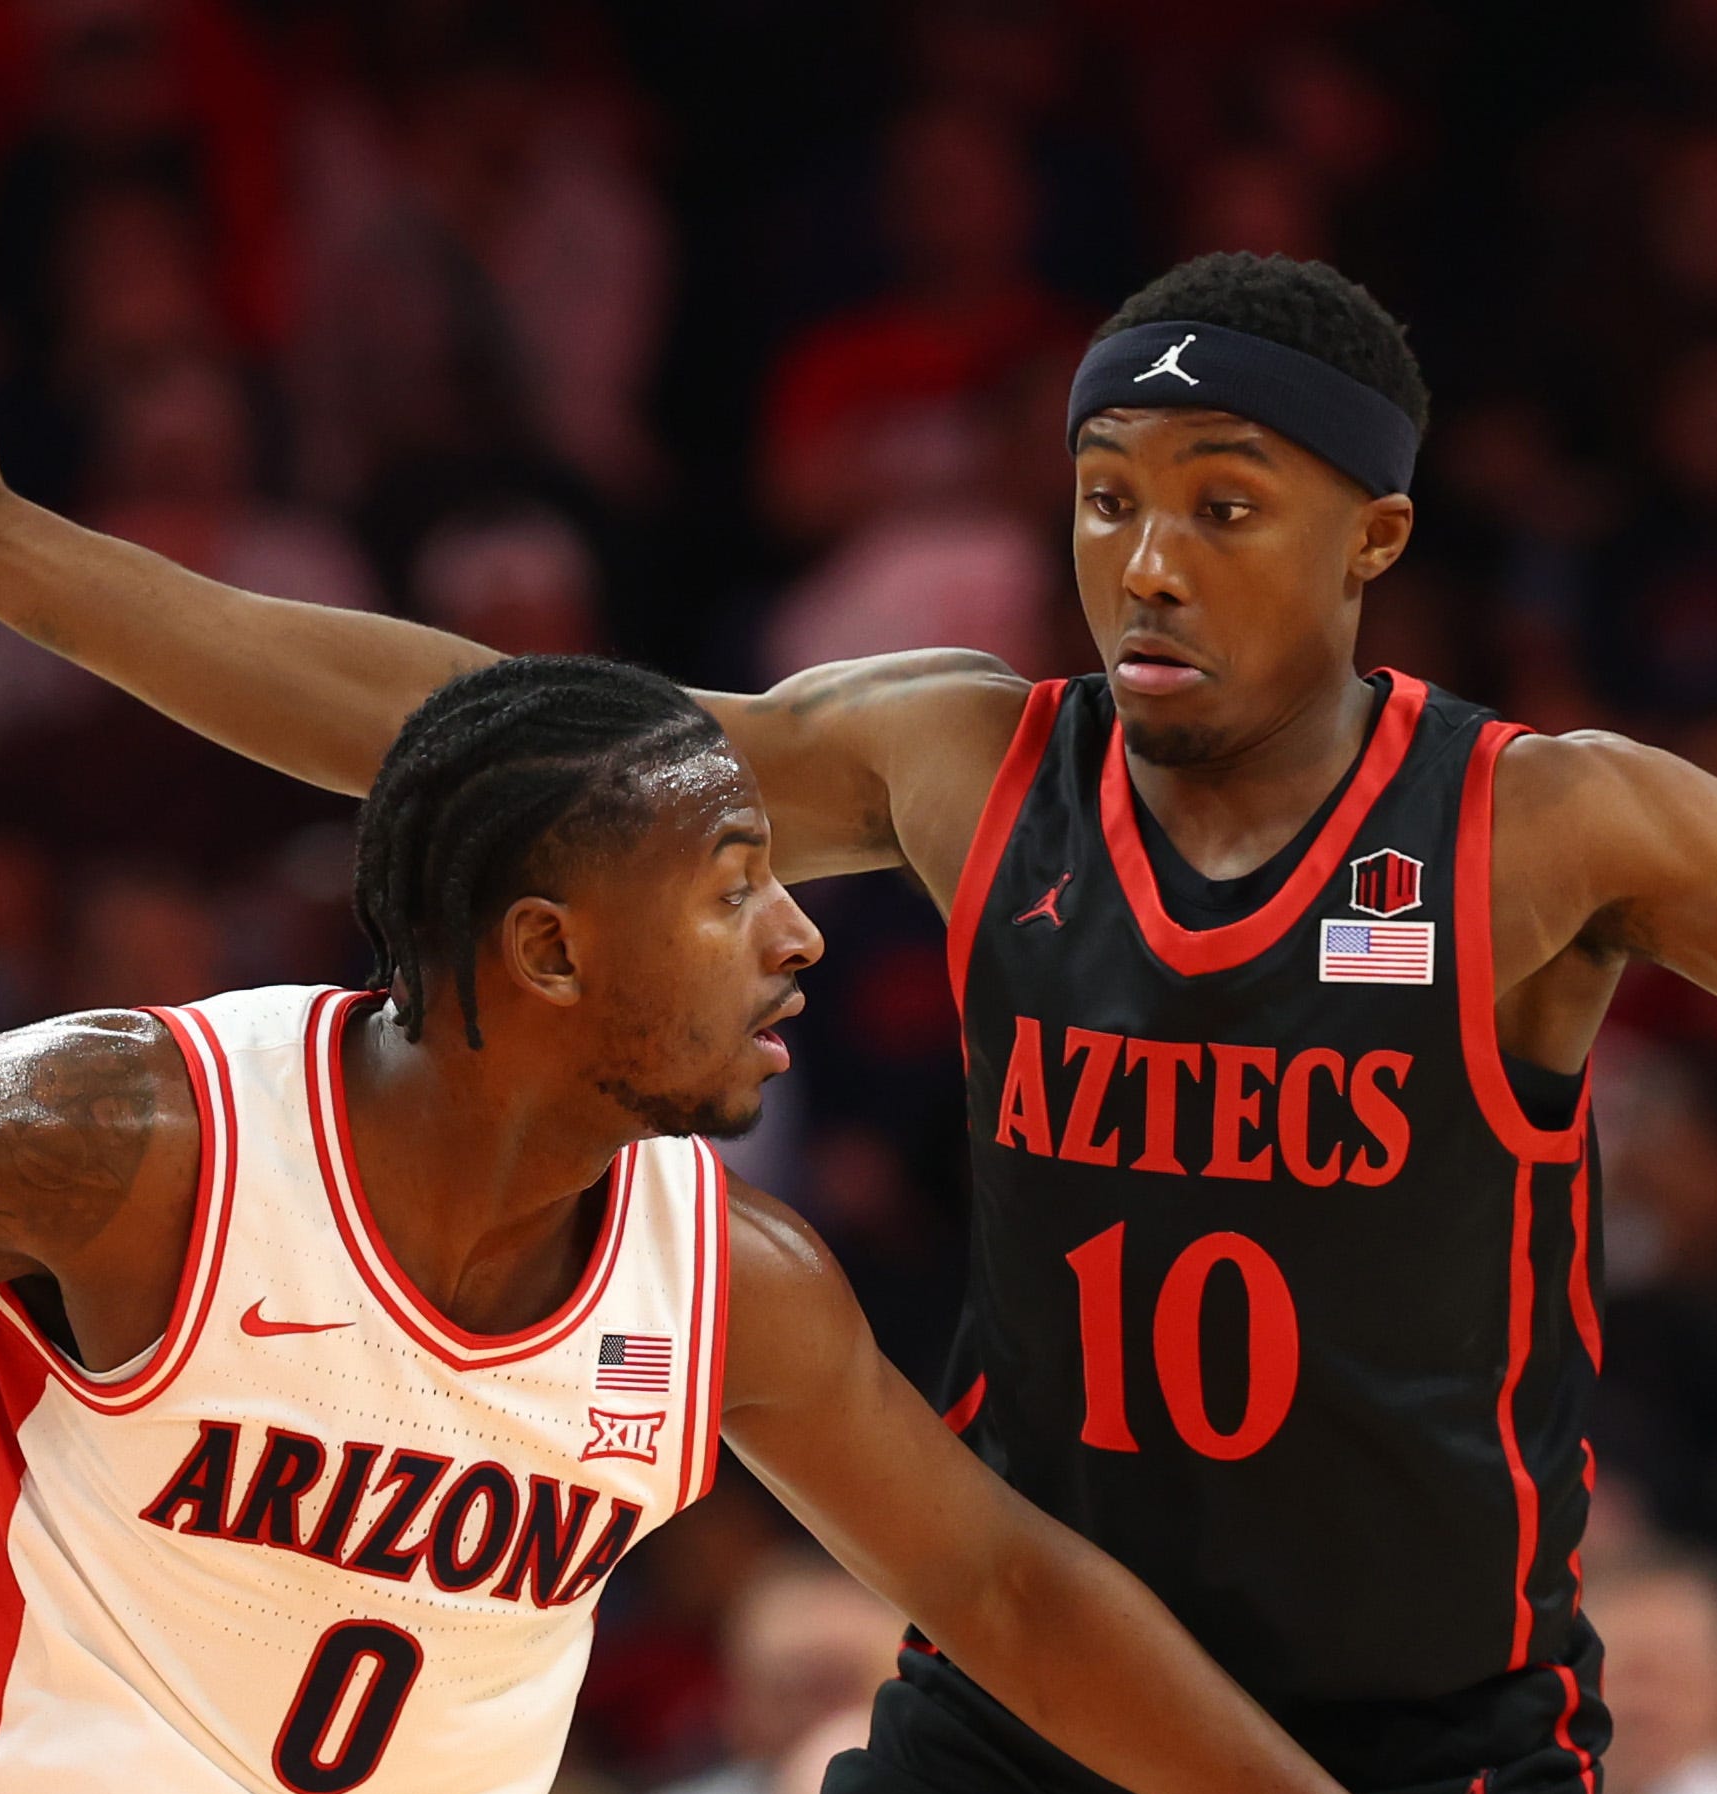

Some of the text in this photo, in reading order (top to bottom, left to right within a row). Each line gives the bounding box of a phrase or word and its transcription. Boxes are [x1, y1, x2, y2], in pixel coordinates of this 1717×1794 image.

[995, 1015, 1414, 1188] AZTECS
[1065, 1220, 1300, 1461] 10
[139, 1420, 644, 1609] ARIZONA
[581, 1407, 666, 1465] XII
